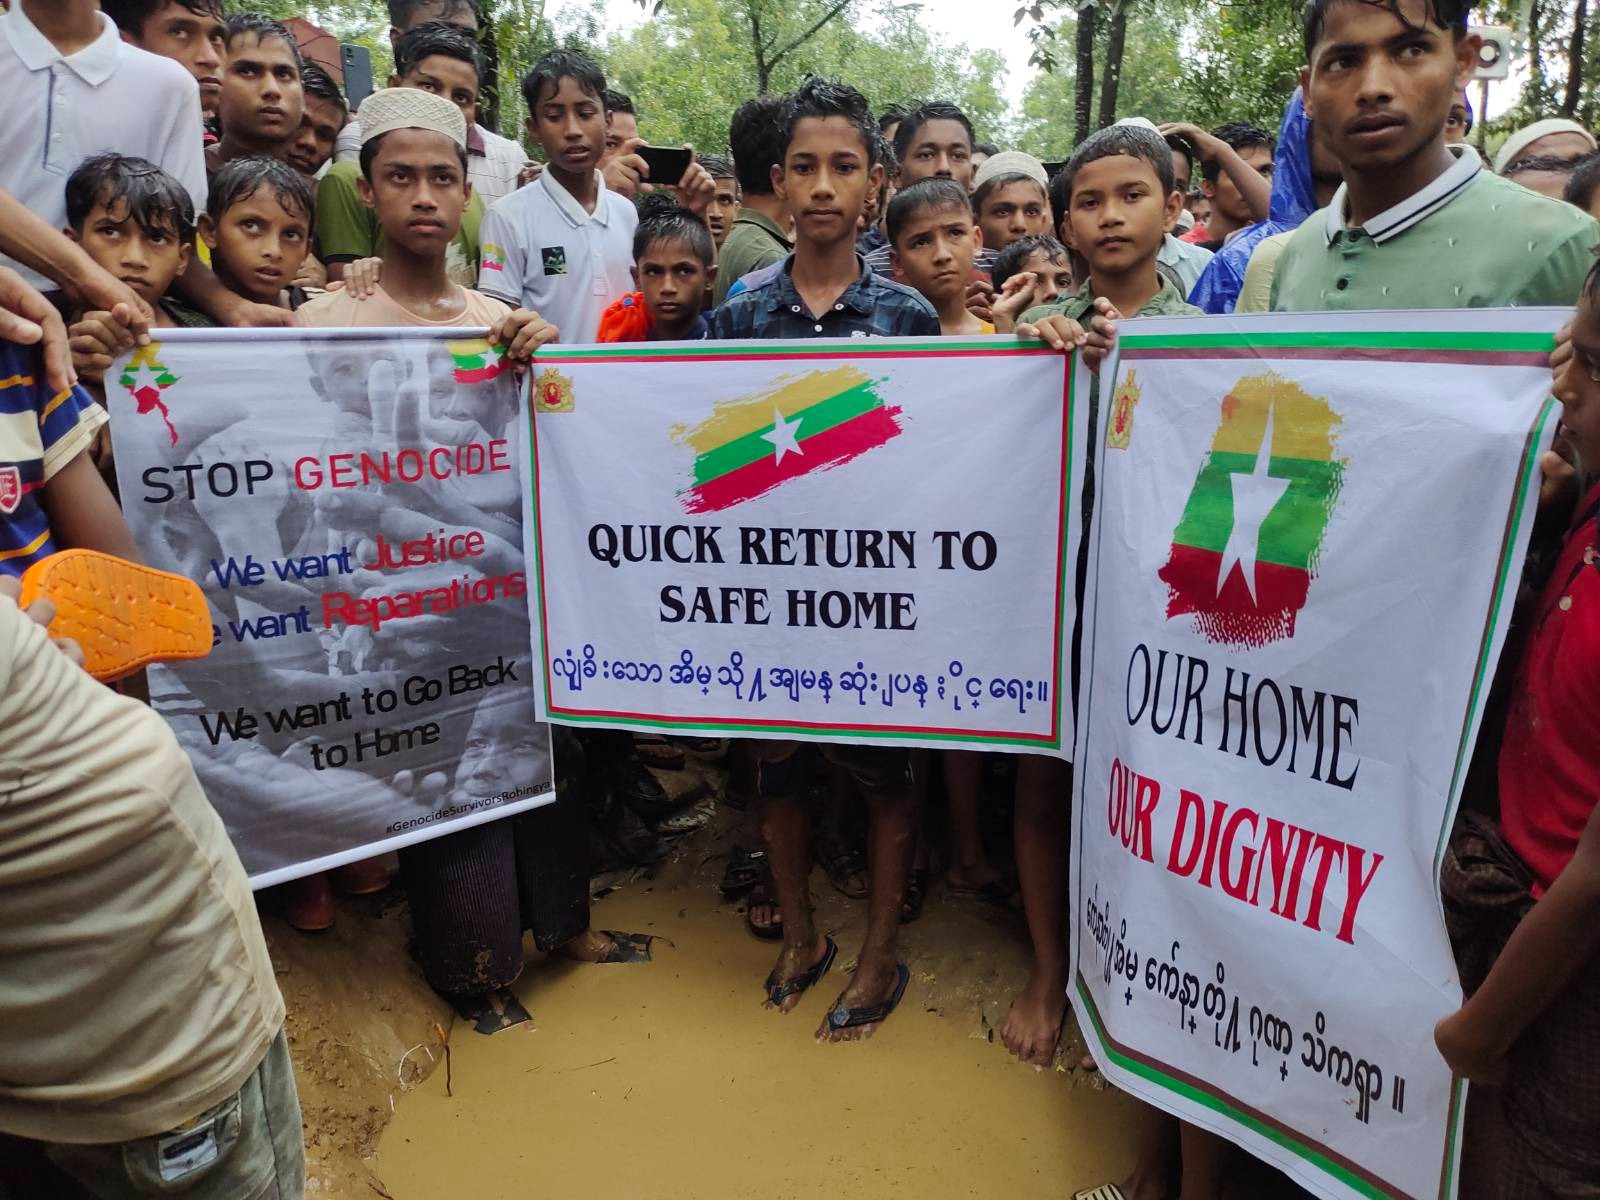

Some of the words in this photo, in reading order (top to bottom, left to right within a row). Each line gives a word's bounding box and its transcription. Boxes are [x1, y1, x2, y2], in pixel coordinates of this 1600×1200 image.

[142, 460, 273, 504] STOP
[294, 439, 511, 491] GENOCIDE
[211, 555, 266, 590] We
[272, 547, 353, 581] want
[363, 528, 485, 571] Justice
[588, 523, 726, 568] QUICK
[739, 527, 917, 569] RETURN
[933, 530, 998, 571] TO
[228, 605, 312, 642] want
[321, 571, 526, 632] Reparations
[659, 585, 772, 625] SAFE
[786, 589, 918, 631] HOME
[200, 707, 258, 745] We
[265, 691, 353, 733] want
[362, 687, 398, 716] to
[403, 675, 442, 706] Go
[448, 656, 519, 697] Back
[1126, 643, 1209, 745] OUR
[1217, 666, 1361, 792] HOME
[310, 742, 348, 771] to
[354, 721, 440, 762] Home
[386, 780, 551, 834] #GenocideSurvivorsRohingya
[1107, 757, 1161, 863] OUR
[1166, 788, 1384, 945] DIGNITY
